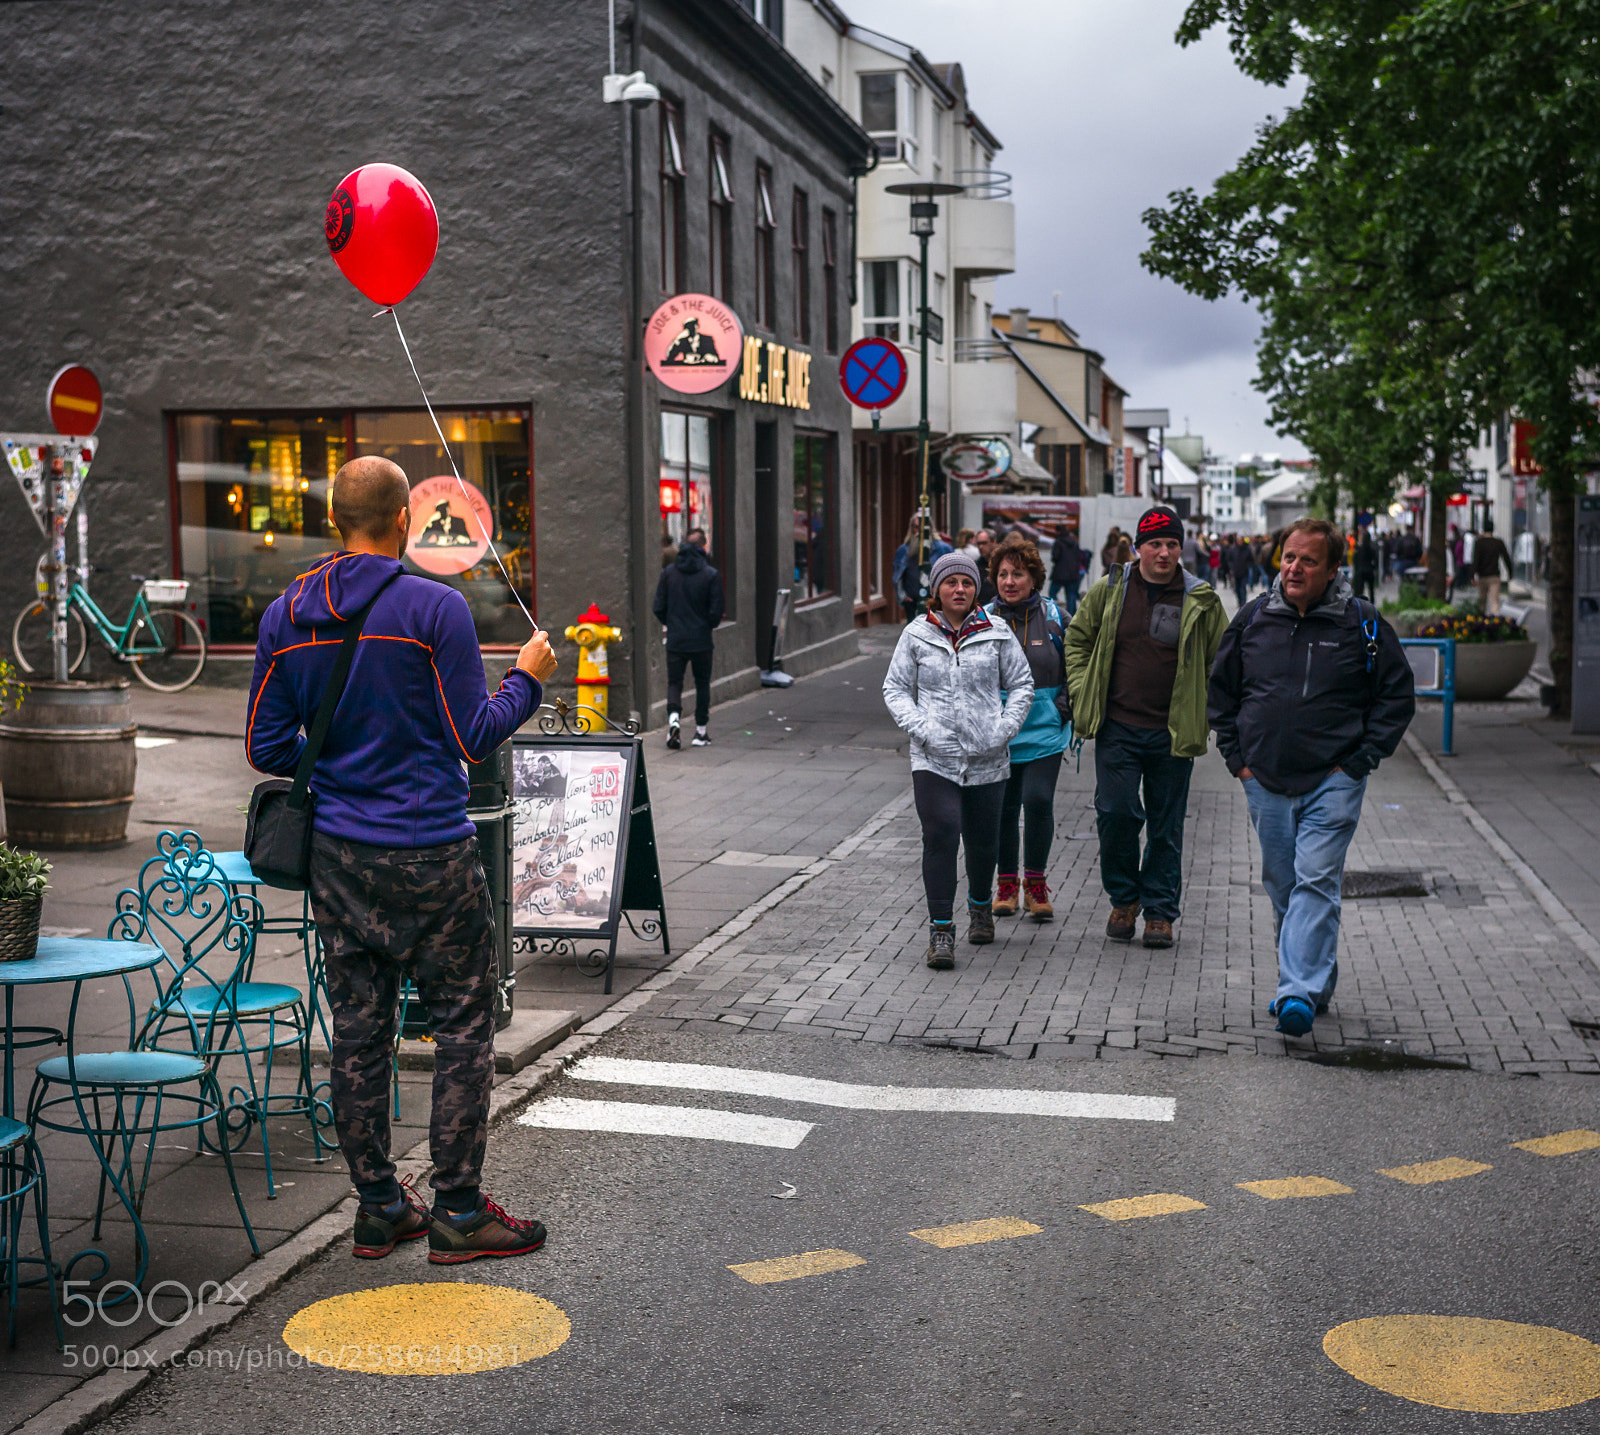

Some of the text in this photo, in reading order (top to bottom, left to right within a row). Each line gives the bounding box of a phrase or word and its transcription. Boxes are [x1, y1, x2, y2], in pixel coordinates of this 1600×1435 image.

[652, 300, 735, 334] JOE & THE JUICE
[739, 335, 762, 400] JOE
[767, 342, 786, 405] THE
[786, 348, 811, 410] JUICE
[433, 482, 453, 493] THE
[589, 769, 615, 791] 990
[591, 799, 614, 820] 990
[539, 829, 587, 878] Cocktails
[590, 831, 614, 852] 1990
[583, 866, 606, 888] 1690
